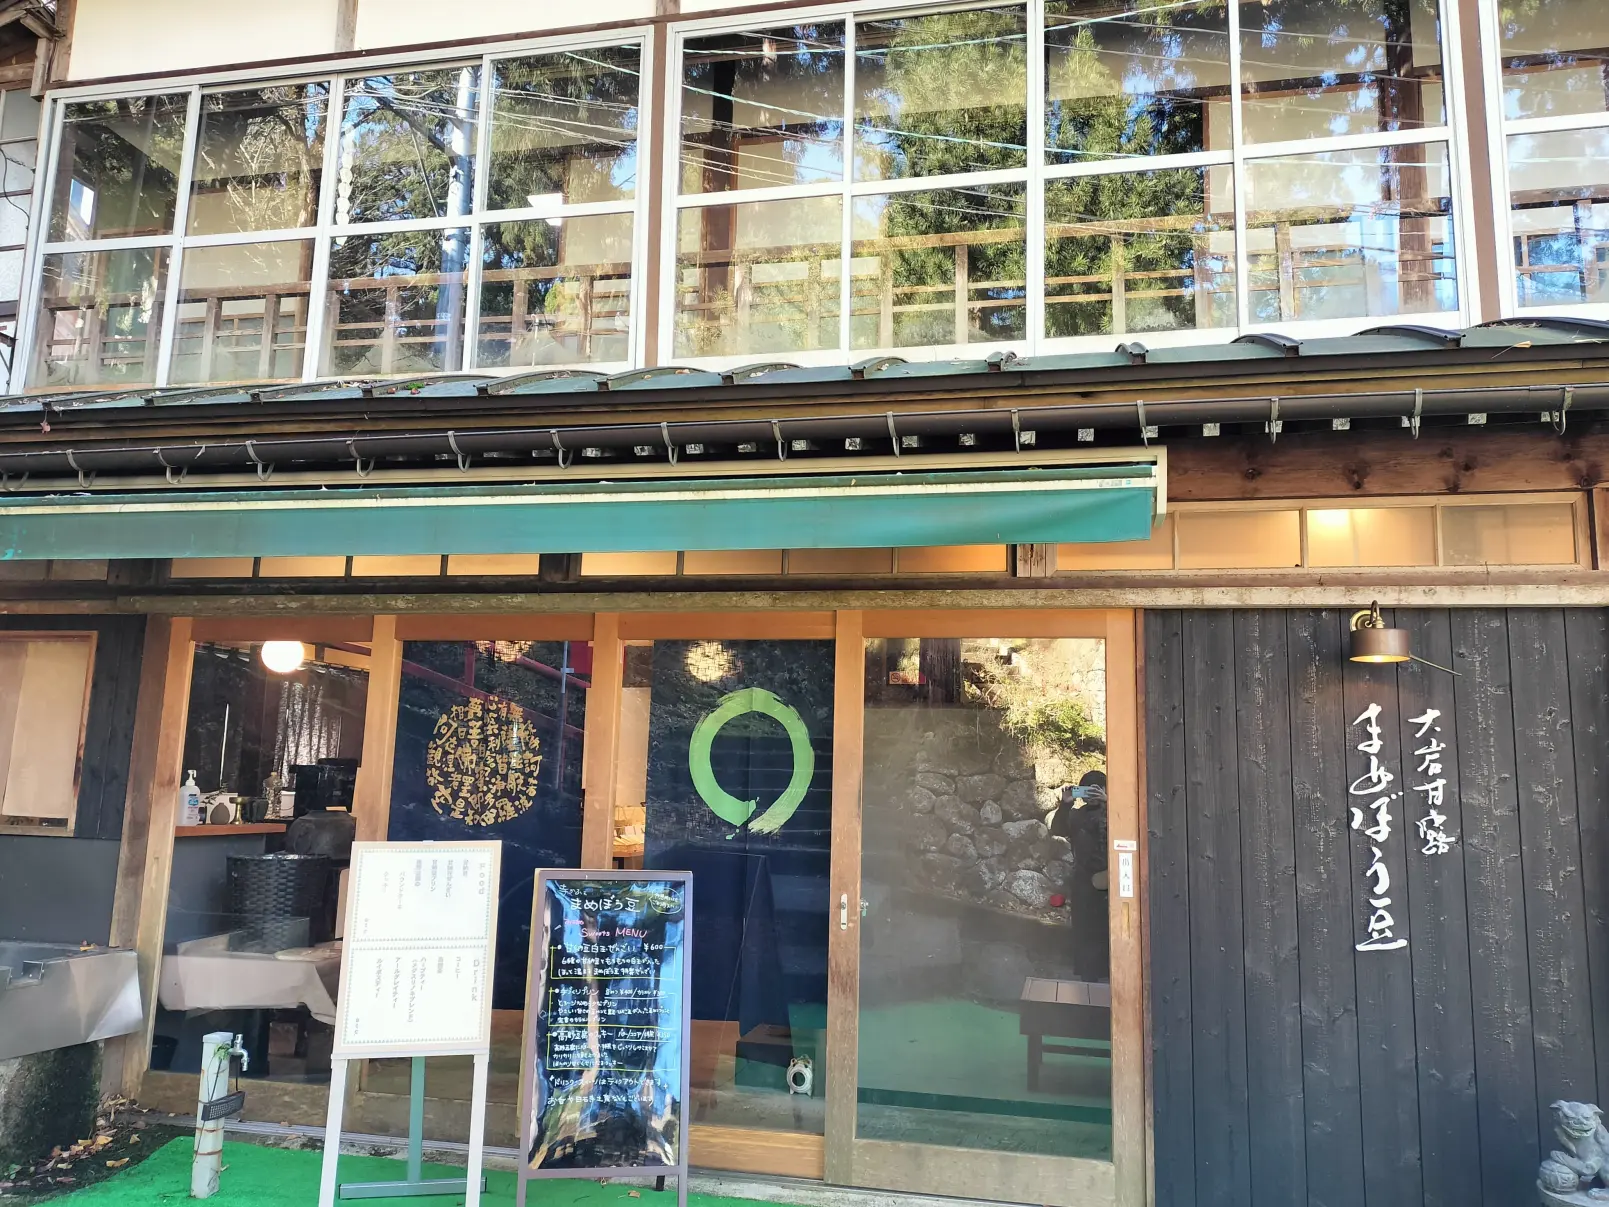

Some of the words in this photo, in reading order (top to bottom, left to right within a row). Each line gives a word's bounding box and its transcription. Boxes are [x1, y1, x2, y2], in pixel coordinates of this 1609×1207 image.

[1349, 702, 1408, 952] まめぼう豆
[570, 895, 640, 913] まめぼう豆
[579, 927, 610, 938] Sweets
[615, 927, 648, 938] MENU
